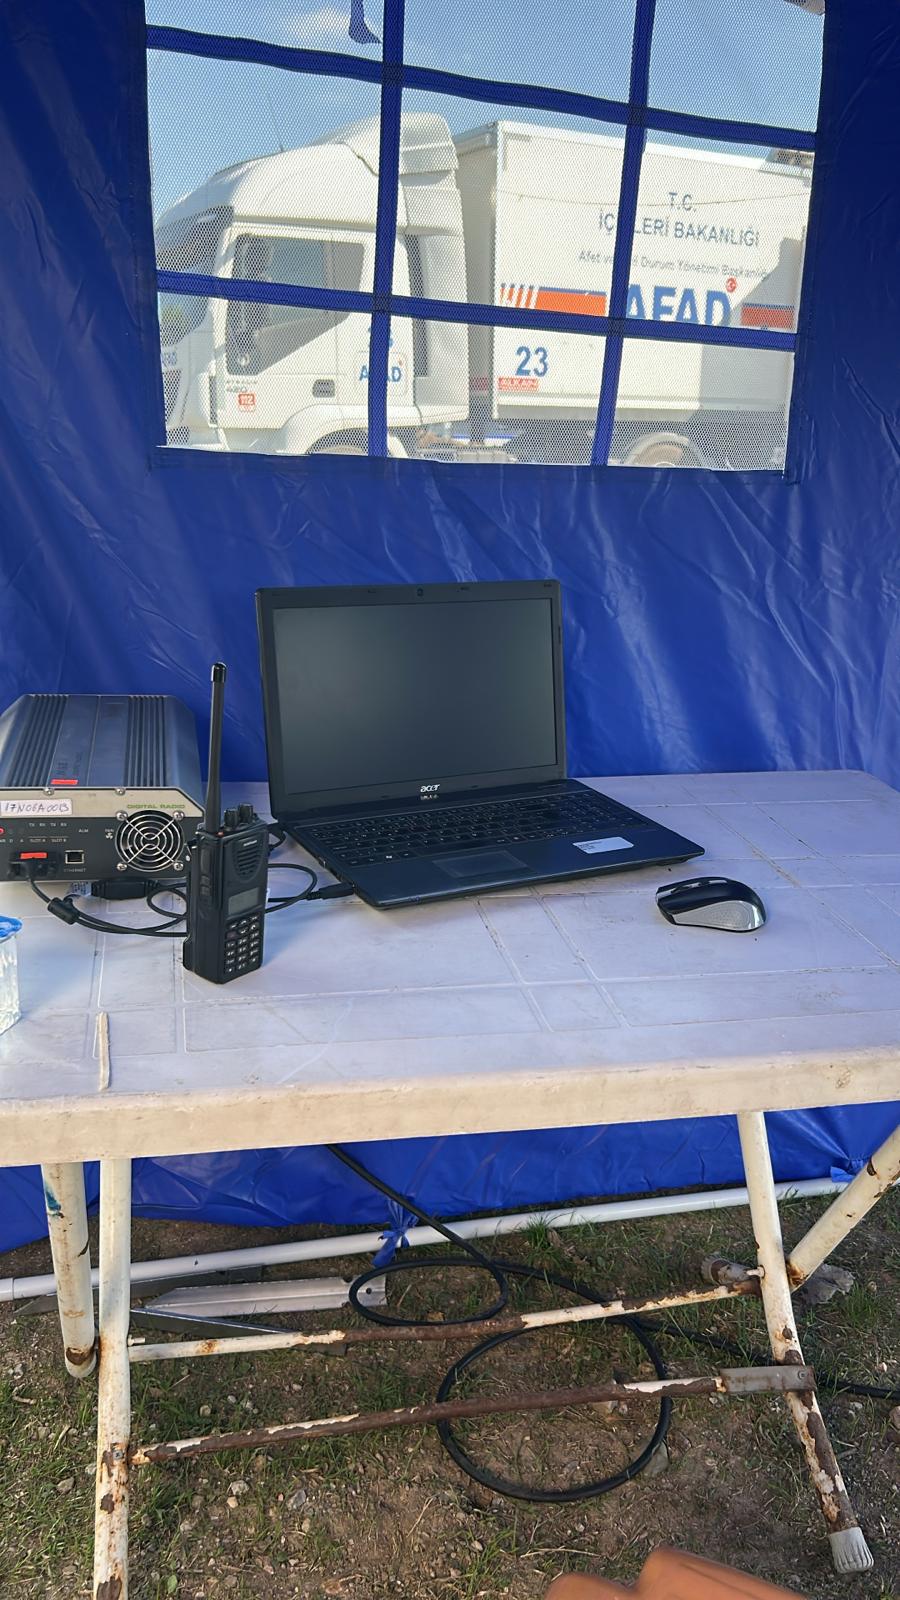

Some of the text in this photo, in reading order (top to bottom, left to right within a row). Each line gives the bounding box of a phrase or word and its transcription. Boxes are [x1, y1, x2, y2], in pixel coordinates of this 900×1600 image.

[669, 192, 697, 212] T.C.
[673, 221, 760, 247] BAKANLIĞI
[515, 345, 550, 378] 23
[420, 784, 440, 793] acer
